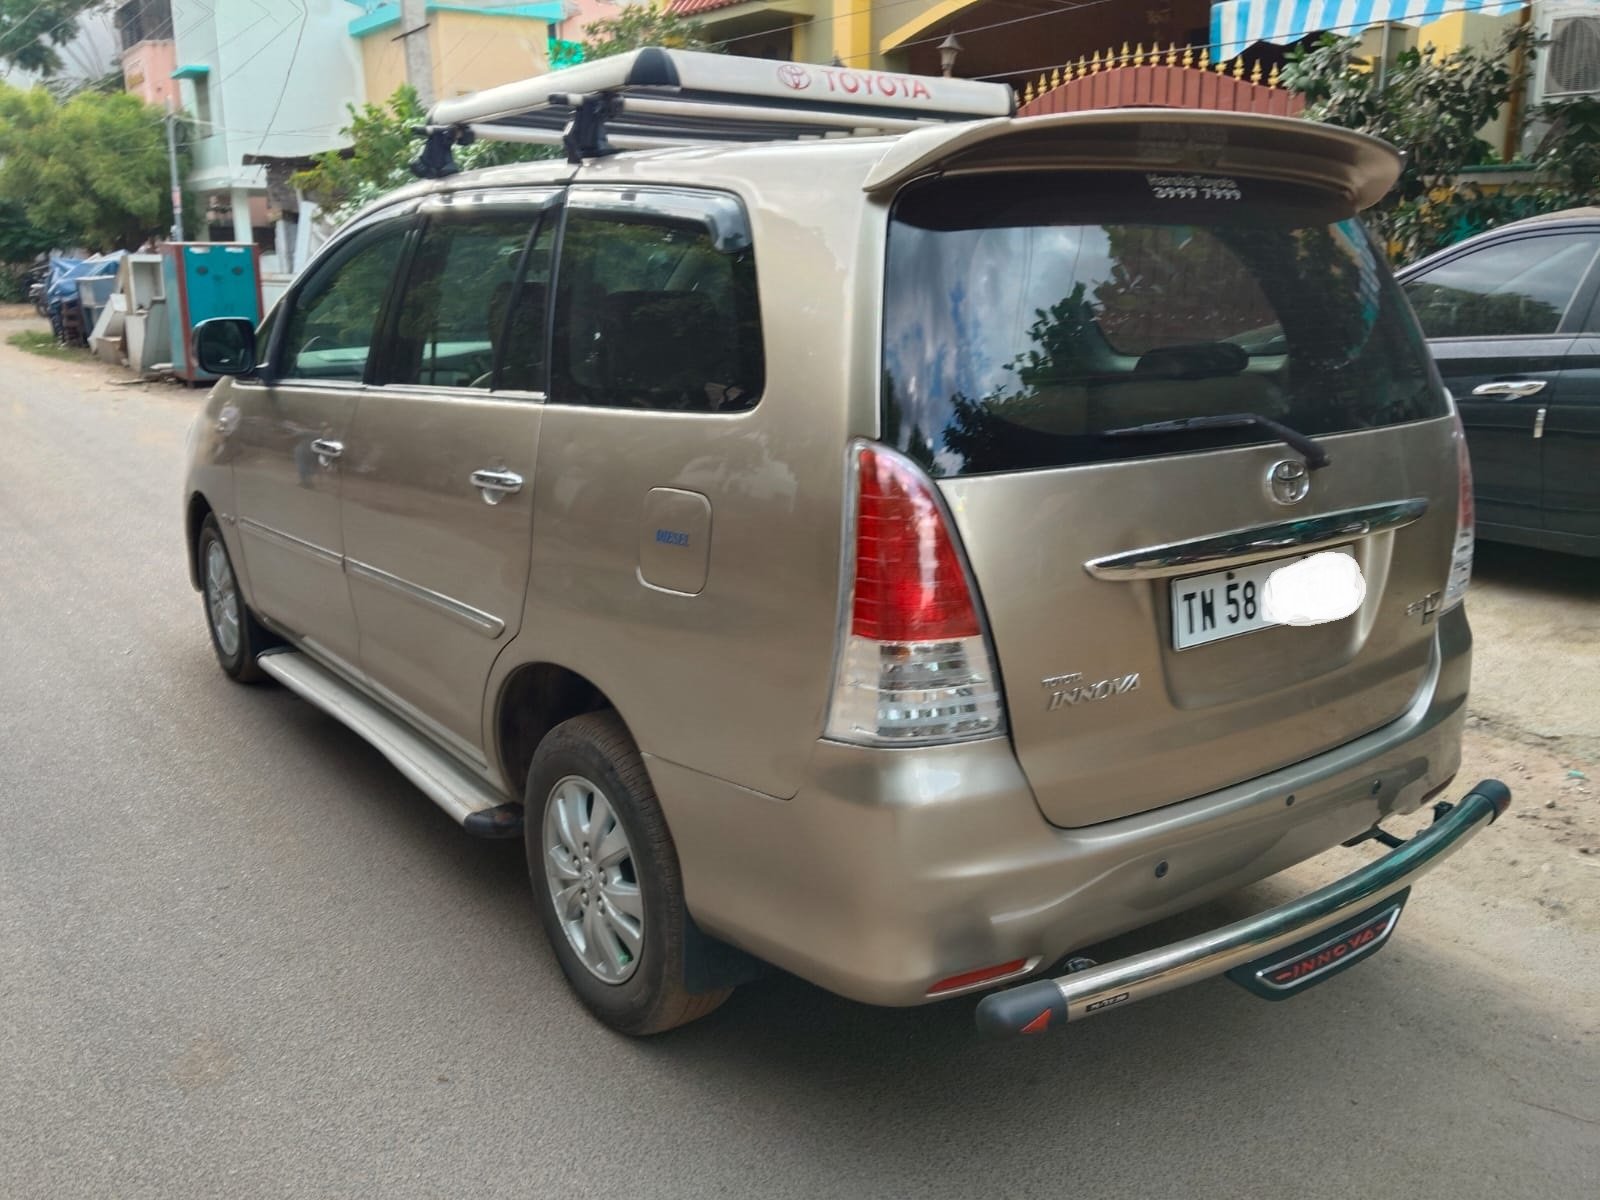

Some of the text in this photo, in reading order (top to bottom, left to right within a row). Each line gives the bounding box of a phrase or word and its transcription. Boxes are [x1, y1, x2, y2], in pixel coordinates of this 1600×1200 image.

[822, 70, 931, 99] TOYOTA
[1182, 580, 1256, 634] TN 58
[1046, 673, 1141, 712] INNOVA
